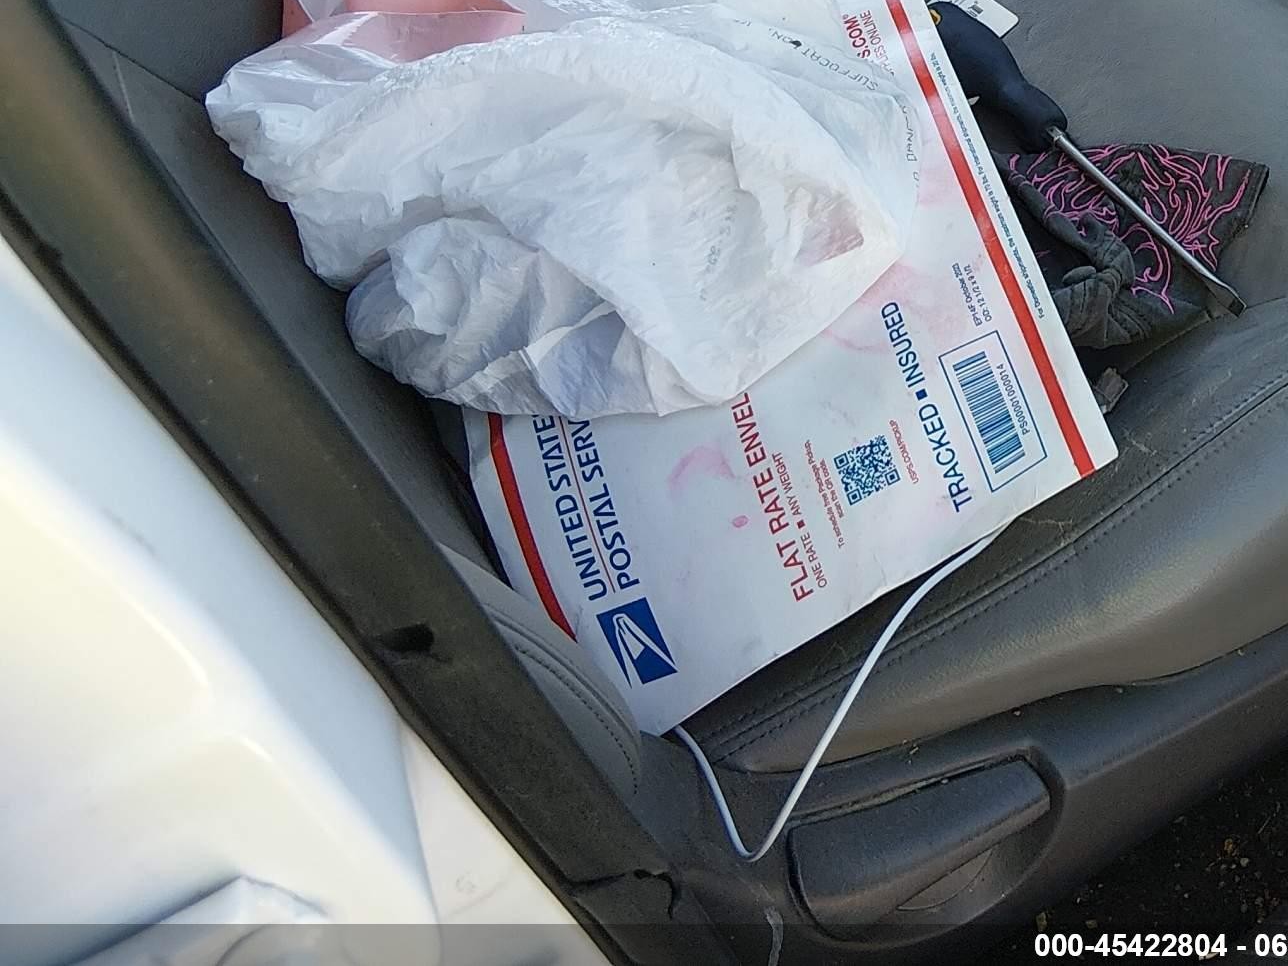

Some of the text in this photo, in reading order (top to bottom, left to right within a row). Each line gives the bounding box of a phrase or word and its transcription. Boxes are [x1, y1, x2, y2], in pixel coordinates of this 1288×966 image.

[858, 9, 881, 46] ONLINE
[996, 212, 1011, 238] maximum
[1011, 246, 1029, 280] shipments,
[957, 276, 973, 303] October
[971, 285, 982, 298] 1/2
[976, 296, 986, 307] 12
[1024, 278, 1041, 307] Domestic
[967, 303, 982, 326] EP14F
[1035, 307, 1045, 319] For
[881, 302, 972, 511] TRACKED INSURED
[995, 362, 1030, 435] PS00001000014
[889, 419, 918, 483] USPS.COM/PICKUP
[729, 391, 813, 601] FLAT RATE ENVEL
[803, 438, 845, 548] To schedule free Package Pickup,
[824, 476, 834, 490] QR
[828, 489, 838, 502] the
[567, 419, 639, 589] POSTAL SERV
[833, 501, 844, 518] scan
[771, 451, 828, 589] ONE RATE ANY WEIGHT
[555, 492, 607, 600] UNITED
